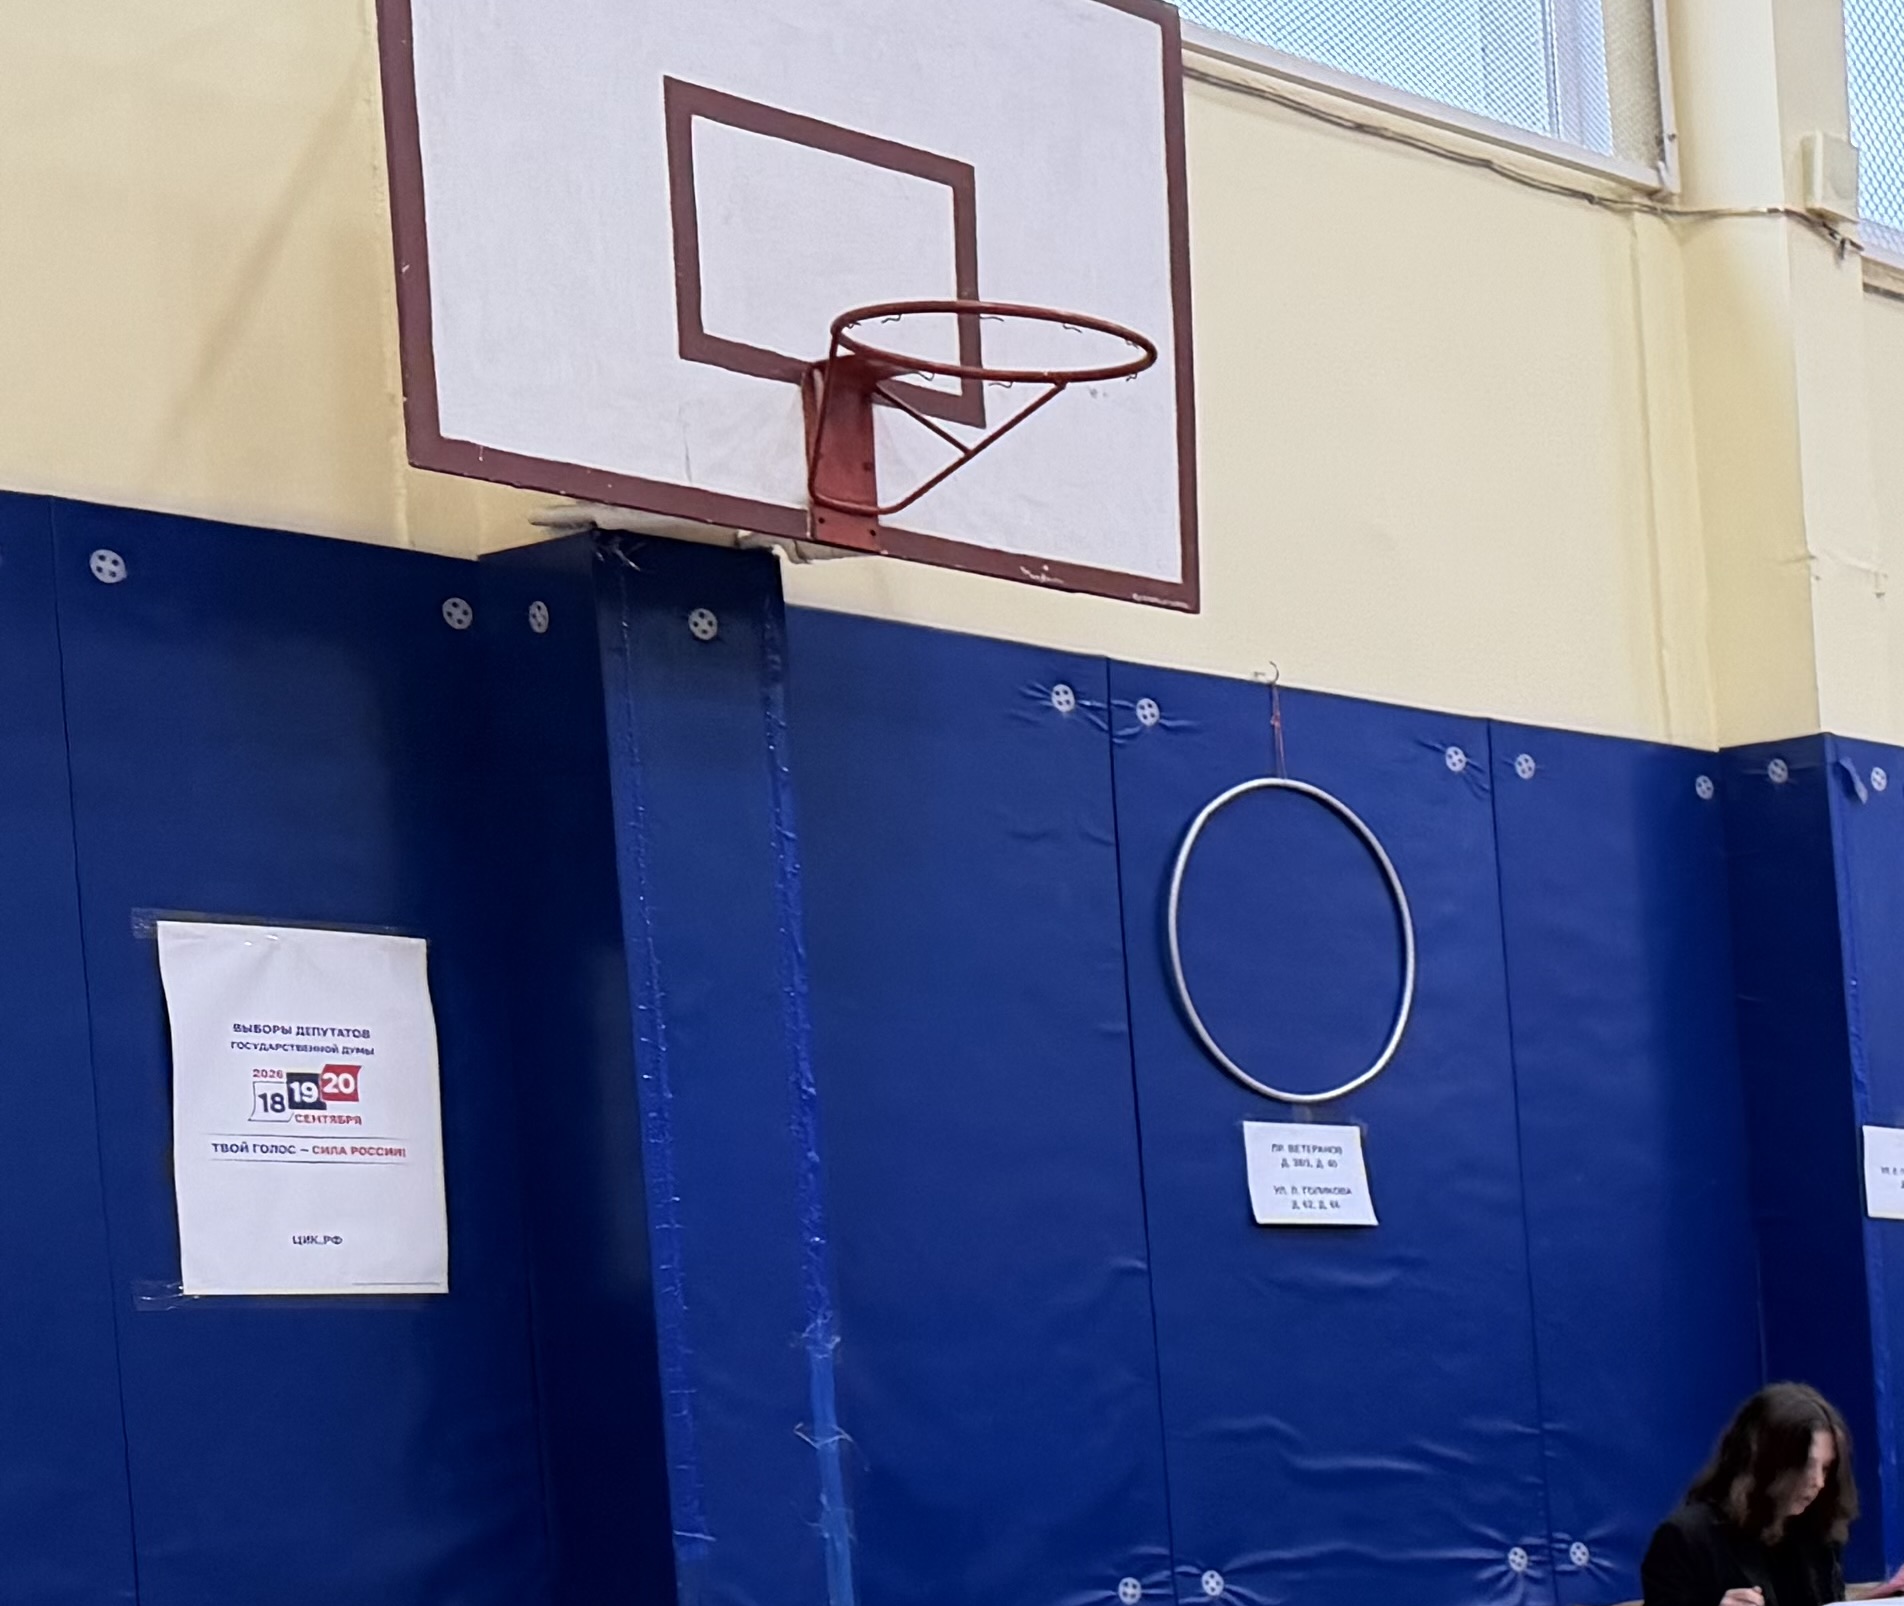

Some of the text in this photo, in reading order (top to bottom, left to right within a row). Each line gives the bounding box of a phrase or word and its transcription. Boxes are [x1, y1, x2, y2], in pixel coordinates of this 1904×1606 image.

[232, 1022, 371, 1040] ВЫБОРЫ ДЕПУТАТОВ
[252, 1068, 284, 1080] 2026
[259, 1072, 356, 1114] 18 19 20
[295, 1113, 363, 1126] СЕНТЯБРЯ
[211, 1141, 249, 1155] ТВОЙ
[252, 1143, 297, 1155] ГОЛОС
[312, 1144, 348, 1157] СИЛА
